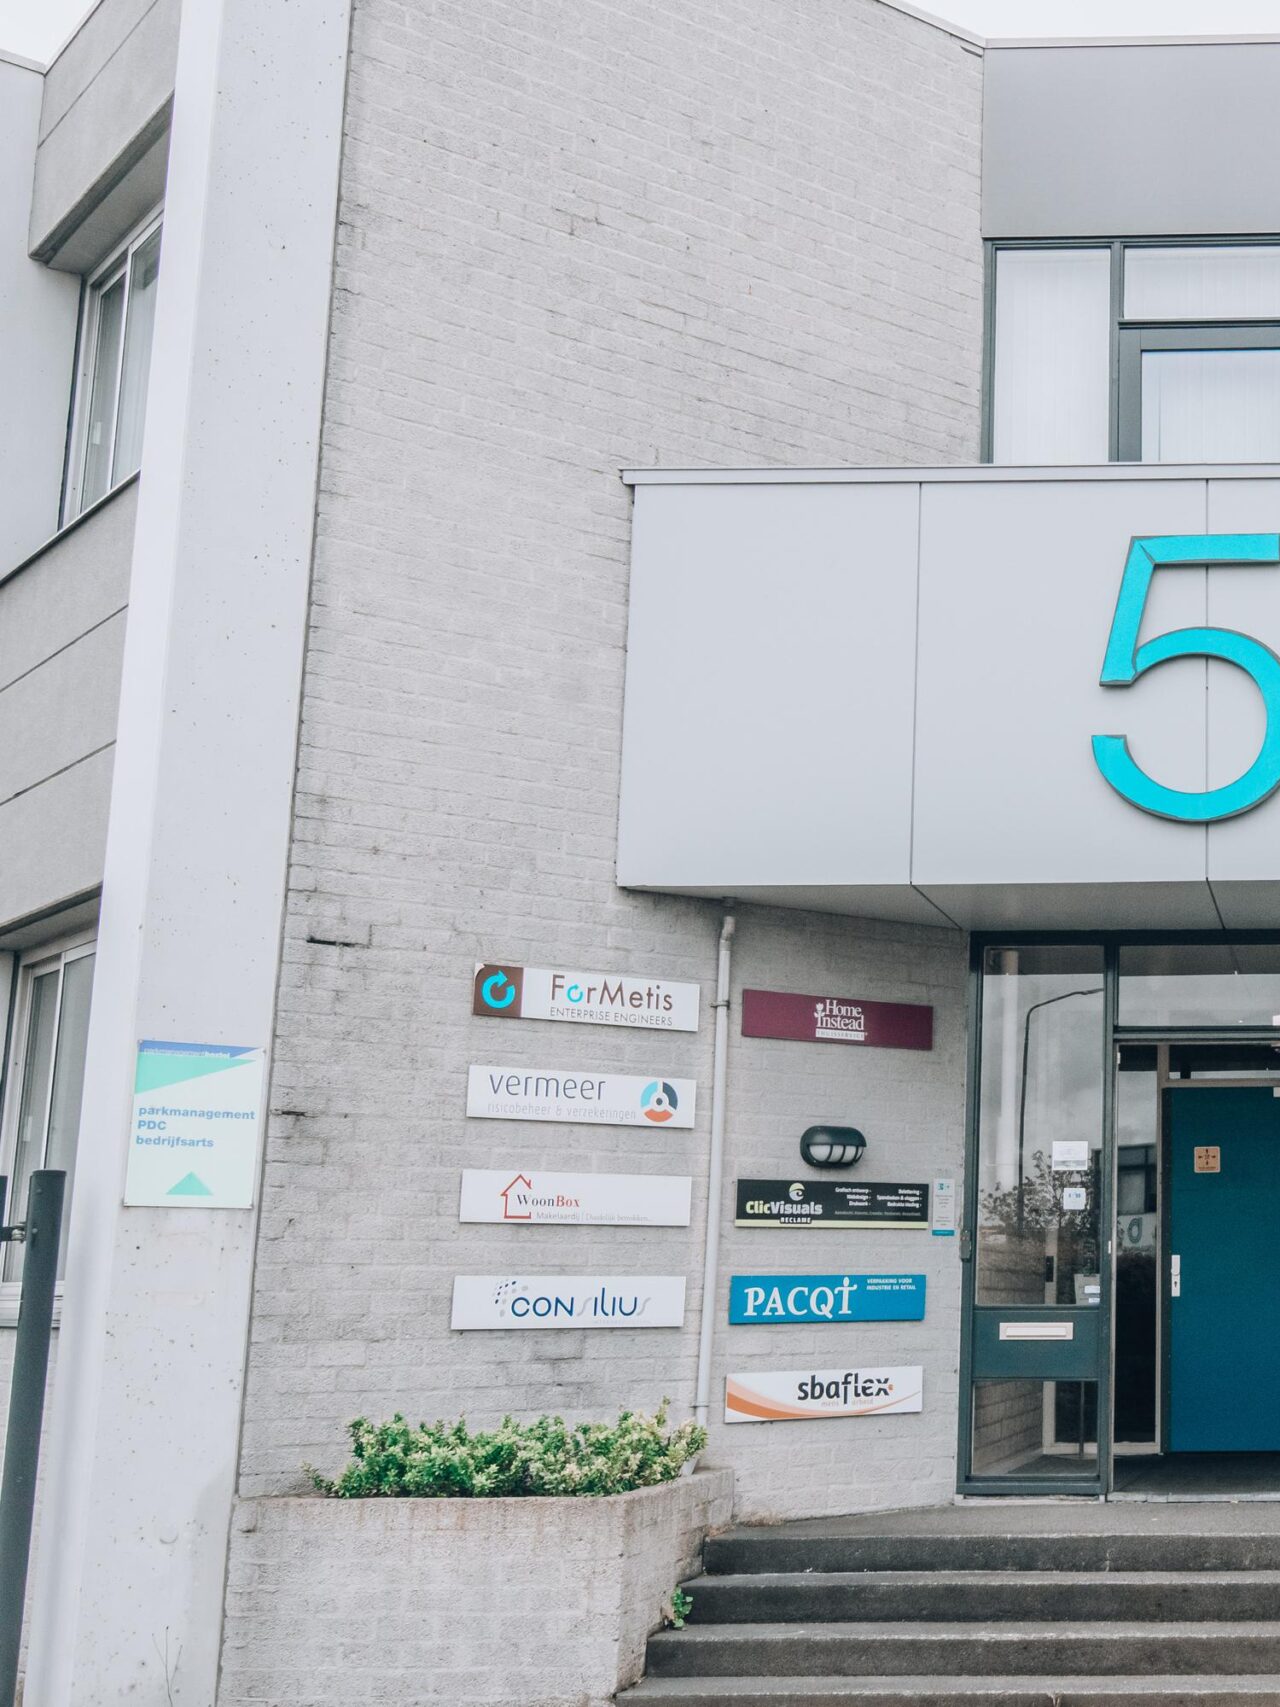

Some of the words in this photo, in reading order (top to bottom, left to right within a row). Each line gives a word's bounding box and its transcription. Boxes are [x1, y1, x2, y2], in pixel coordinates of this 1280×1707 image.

[551, 974, 673, 1011] ForMetis
[550, 1006, 610, 1022] ENTERPRISE
[614, 1012, 673, 1027] ENGINEERS
[825, 999, 862, 1017] Home
[816, 1014, 864, 1030] Instead
[489, 1074, 606, 1100] vermeer
[138, 1106, 255, 1120] parkmanagement
[487, 1102, 551, 1117] risicobeheer
[567, 1107, 637, 1122] verzekeringen
[137, 1120, 167, 1131] PDC
[136, 1135, 214, 1148] bedrijfsarts
[516, 1194, 580, 1207] WoonBox
[746, 1200, 823, 1215] ClicVisuals
[797, 1372, 890, 1405] sbaflex
